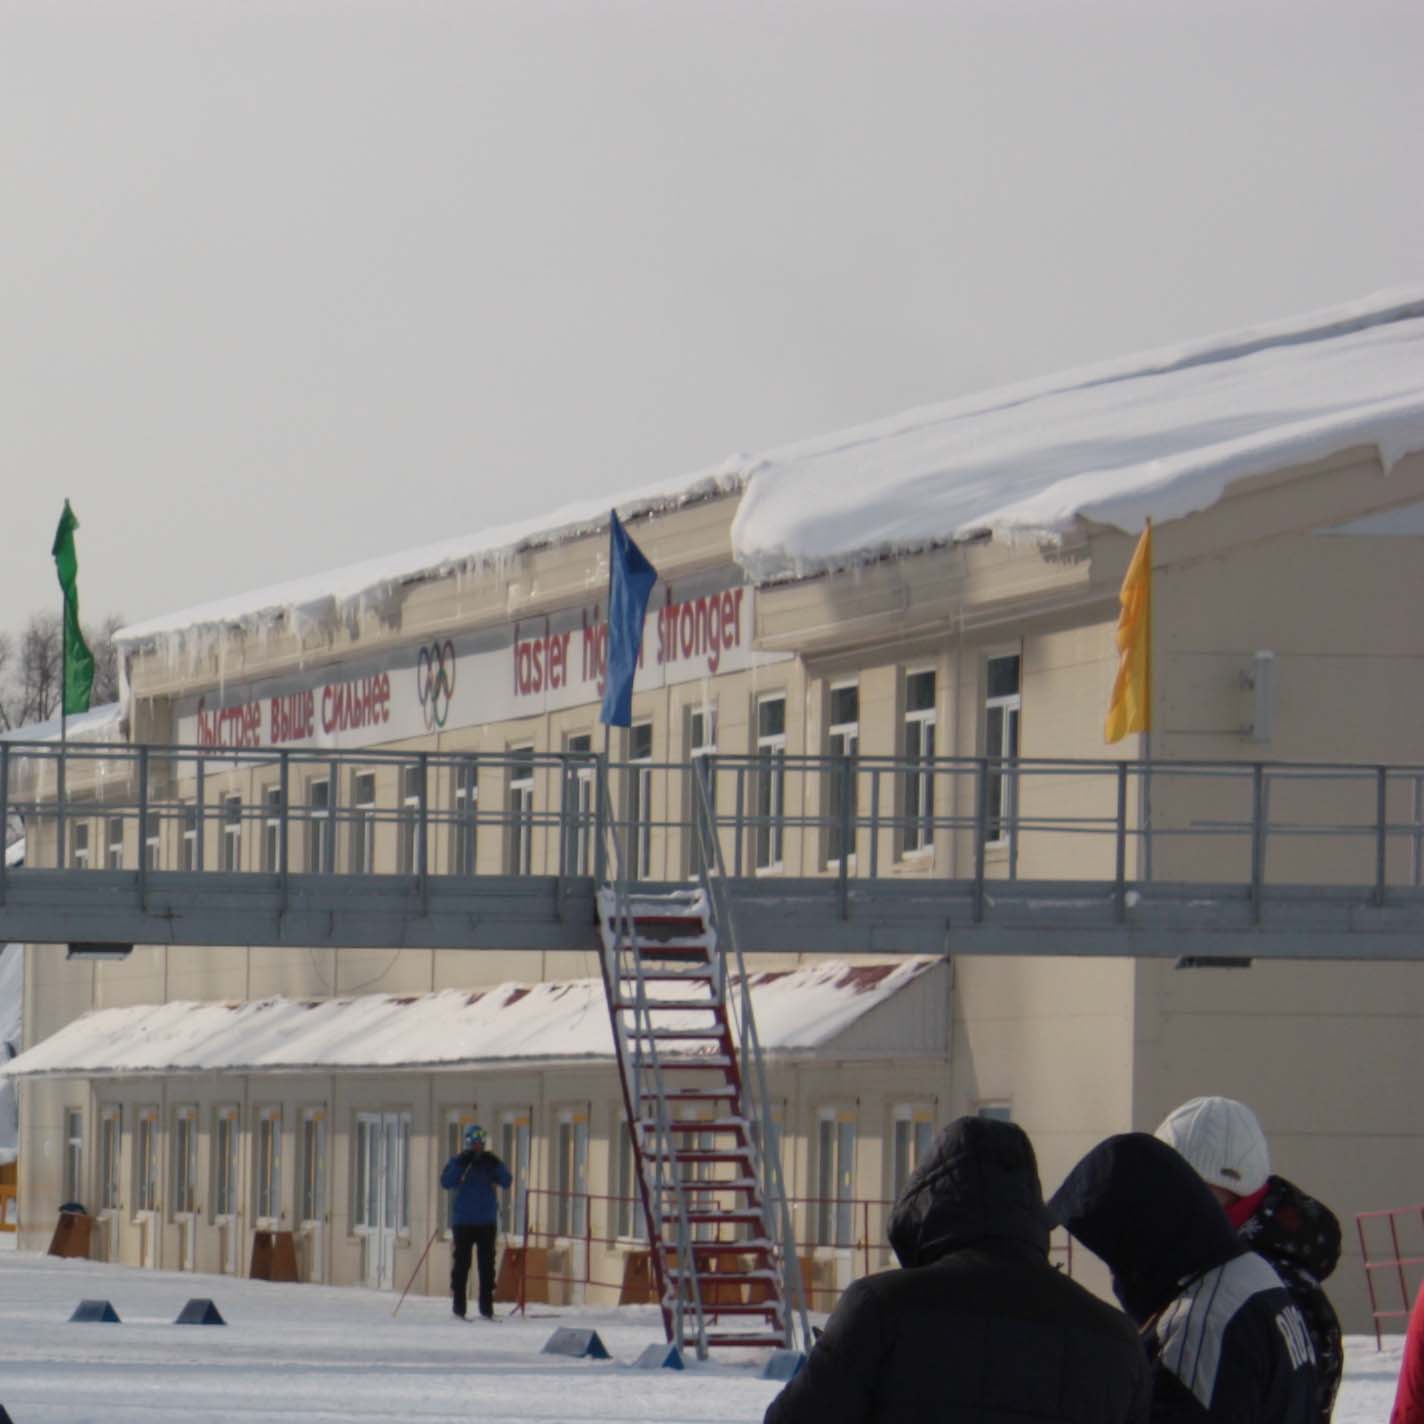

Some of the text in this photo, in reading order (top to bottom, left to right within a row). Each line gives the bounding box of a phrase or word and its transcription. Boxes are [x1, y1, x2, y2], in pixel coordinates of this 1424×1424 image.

[513, 615, 570, 697] faster
[656, 586, 743, 673] stronger
[270, 690, 315, 744] выше
[321, 671, 391, 735] сильнее
